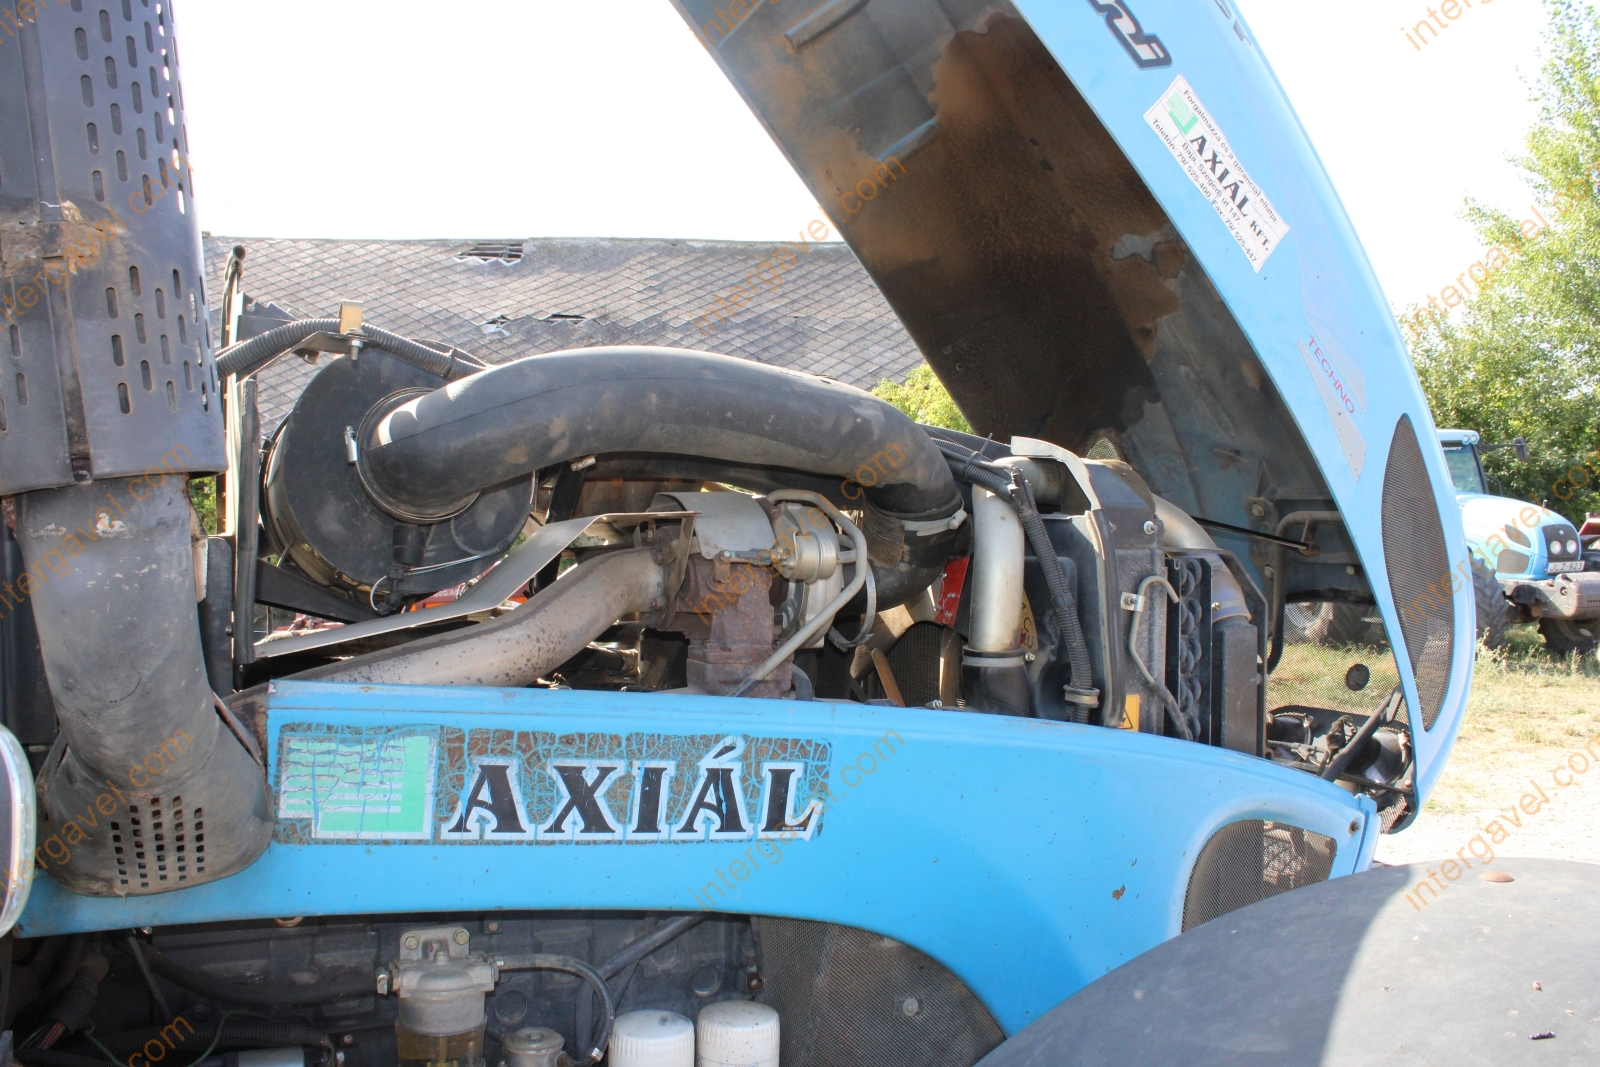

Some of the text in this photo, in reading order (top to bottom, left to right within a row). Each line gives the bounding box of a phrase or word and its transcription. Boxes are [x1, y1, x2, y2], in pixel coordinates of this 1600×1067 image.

[1152, 119, 1177, 152] Telefon:
[1211, 200, 1225, 218] Fax:
[1233, 231, 1256, 263] 525-447
[1181, 142, 1241, 225] Baja, Szegedi út 147.
[1183, 90, 1221, 142] Forgalmazza
[1220, 141, 1229, 153] és
[1233, 159, 1260, 198] garanciát
[1190, 133, 1270, 252] AXIÁL KFT.
[1308, 334, 1355, 414] TECHNO
[443, 737, 822, 838] AXIÁL
